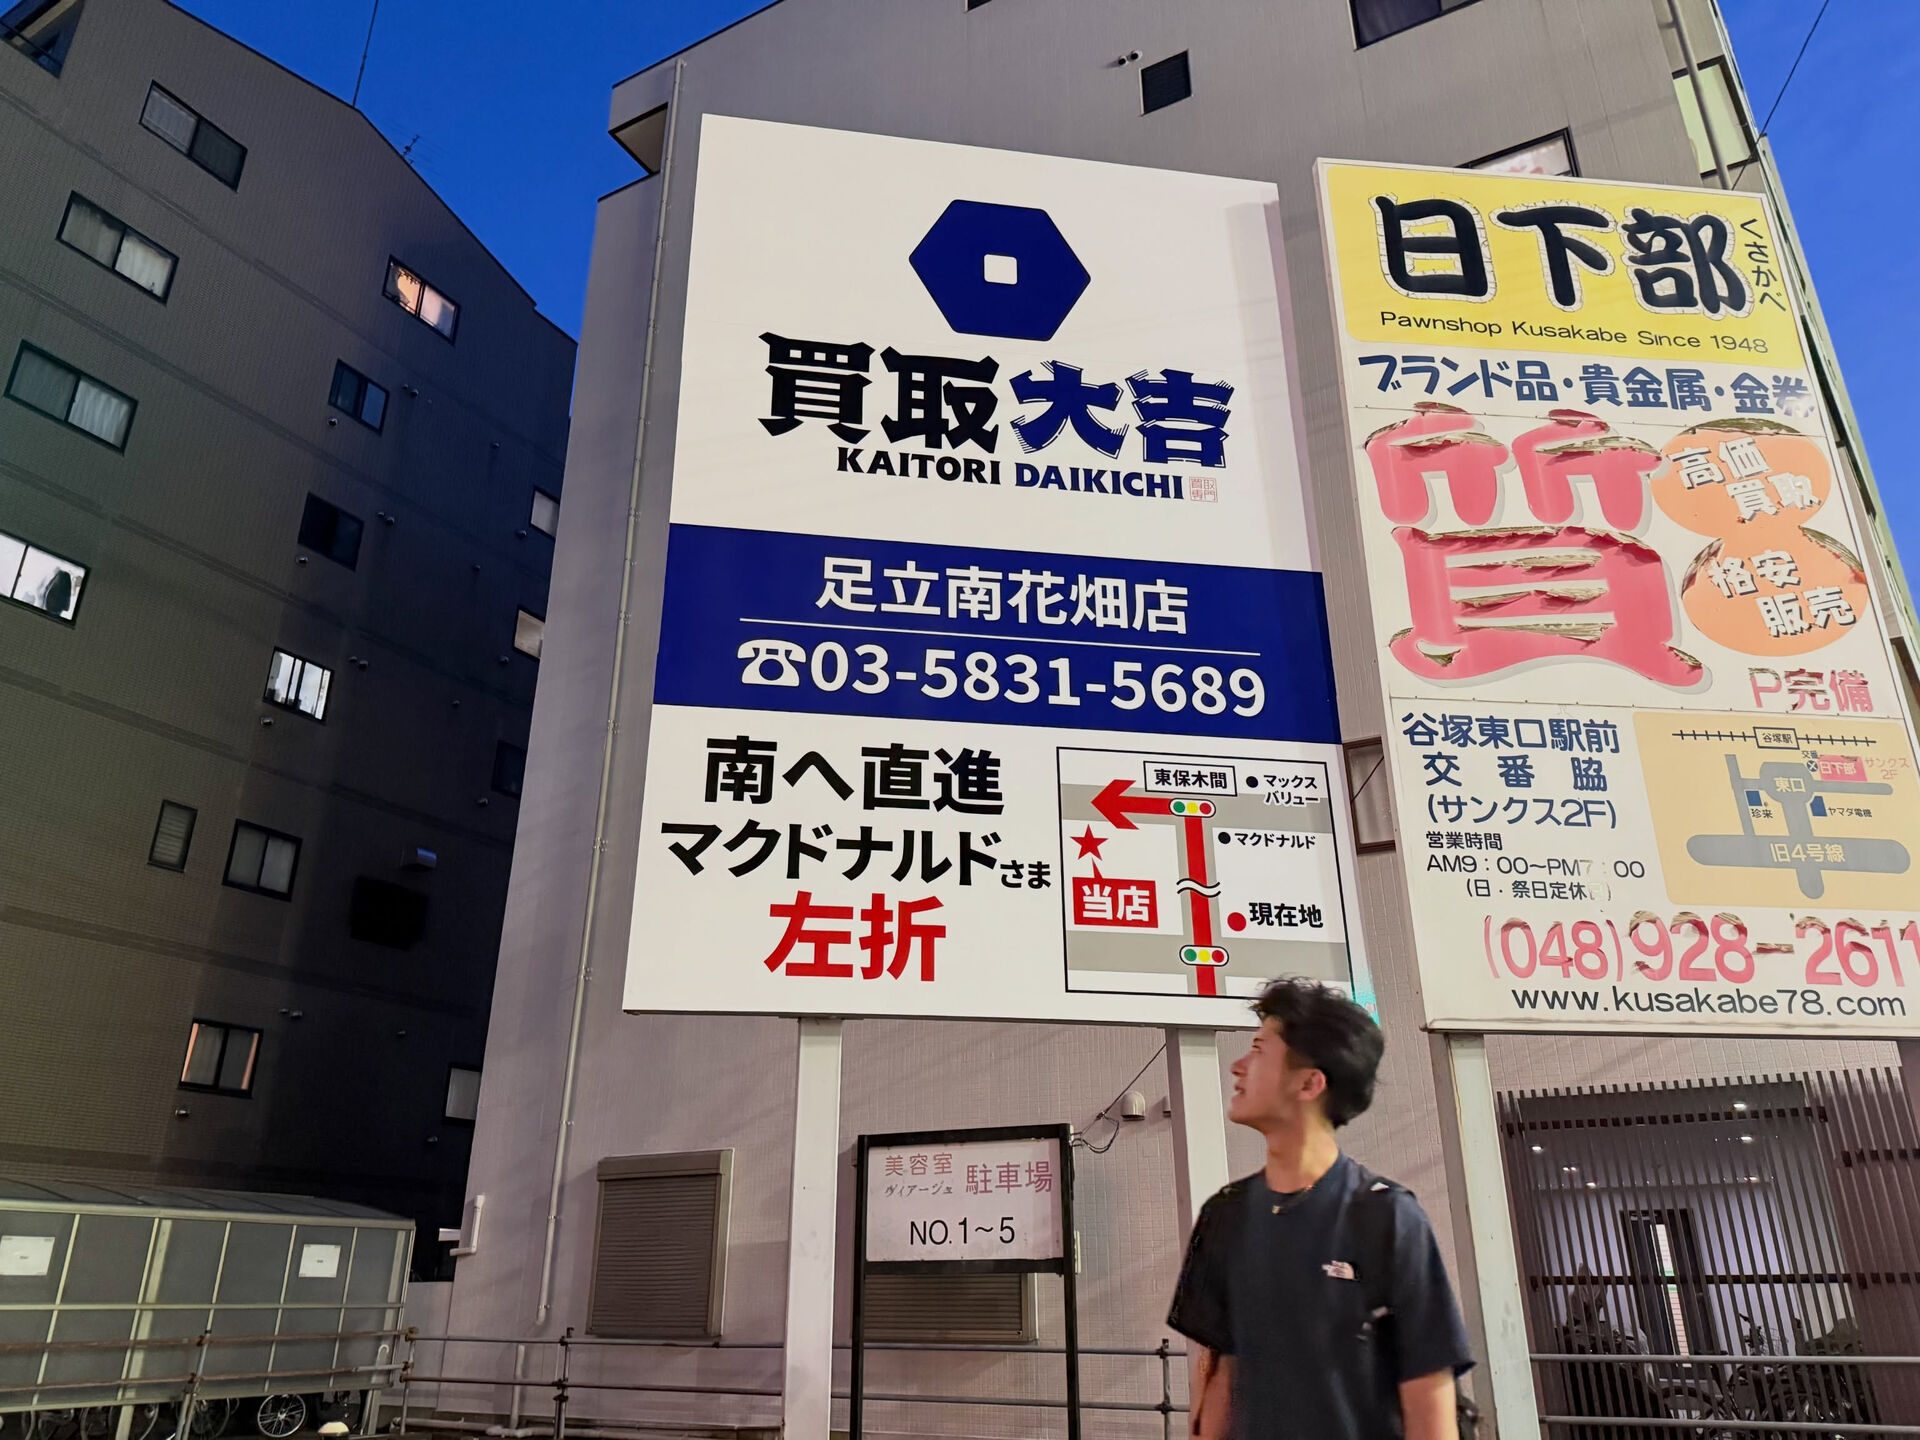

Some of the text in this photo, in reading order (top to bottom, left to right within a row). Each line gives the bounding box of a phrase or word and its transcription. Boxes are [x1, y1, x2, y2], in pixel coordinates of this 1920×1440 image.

[1371, 193, 1753, 318] 日下部
[1740, 218, 1787, 313] くさかべ
[1381, 311, 1768, 353] Pawnshop Kusakabe Since 1948
[758, 332, 1235, 468] 買取大吉
[837, 446, 1184, 500] KAITORI DAIKICHI
[1667, 437, 1772, 490] 高価
[1725, 472, 1822, 521] 買取
[1364, 402, 1712, 693] 質
[1707, 550, 1801, 599] 格安
[815, 556, 1189, 635] 足立南花畑店
[1755, 586, 1857, 638] 販売
[809, 642, 1266, 718] 03-5831-5689
[1748, 668, 1875, 712] P完備
[1401, 712, 1620, 753] 谷塚東口駅前
[1762, 733, 1794, 744] 谷塚駅
[705, 735, 1005, 815] 南へ直進
[1154, 768, 1228, 790] 東保木間
[1263, 774, 1318, 789] マックス
[1819, 761, 1857, 775] 日下部
[1865, 758, 1910, 768] サンクス
[1881, 769, 1899, 780] 2F
[1265, 791, 1319, 806] バリュー
[1774, 777, 1806, 793] 東口
[1428, 794, 1617, 829] (サンクス2F)
[660, 818, 1051, 889] マクドナルドさま
[1234, 832, 1316, 849] マクドナルド
[1426, 831, 1503, 850] 営業時間
[1770, 842, 1846, 862] 旧4号線
[1081, 884, 1150, 922] 当店
[1466, 878, 1611, 901] (日・祭日定休)
[1249, 902, 1324, 929] 現在地
[763, 890, 946, 981] 左折
[1511, 986, 1907, 1017] www.kusakabe78.com
[884, 1152, 953, 1177] 美容室
[966, 1161, 1053, 1194] 駐車場
